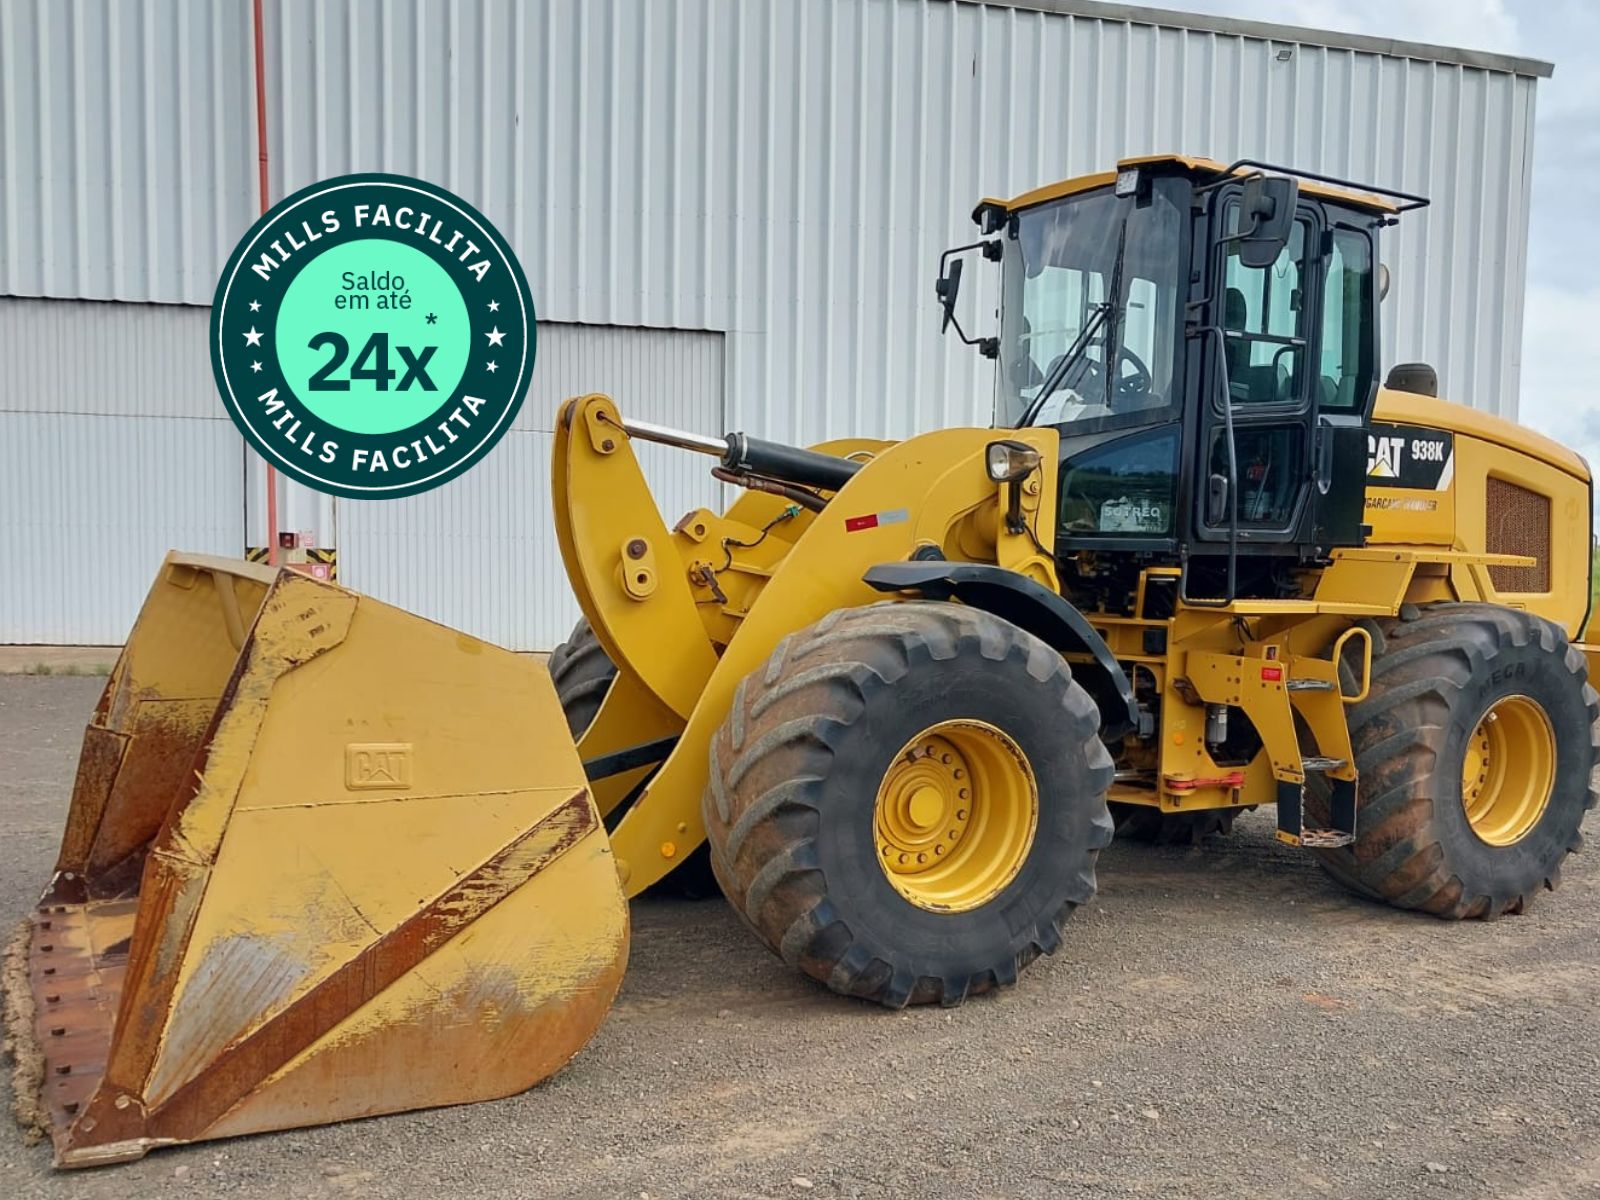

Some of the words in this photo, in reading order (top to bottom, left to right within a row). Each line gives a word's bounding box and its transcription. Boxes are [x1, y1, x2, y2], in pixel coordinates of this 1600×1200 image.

[1411, 439, 1444, 461] 938K
[1103, 506, 1161, 518] SOTREQ
[354, 750, 407, 784] CAT
